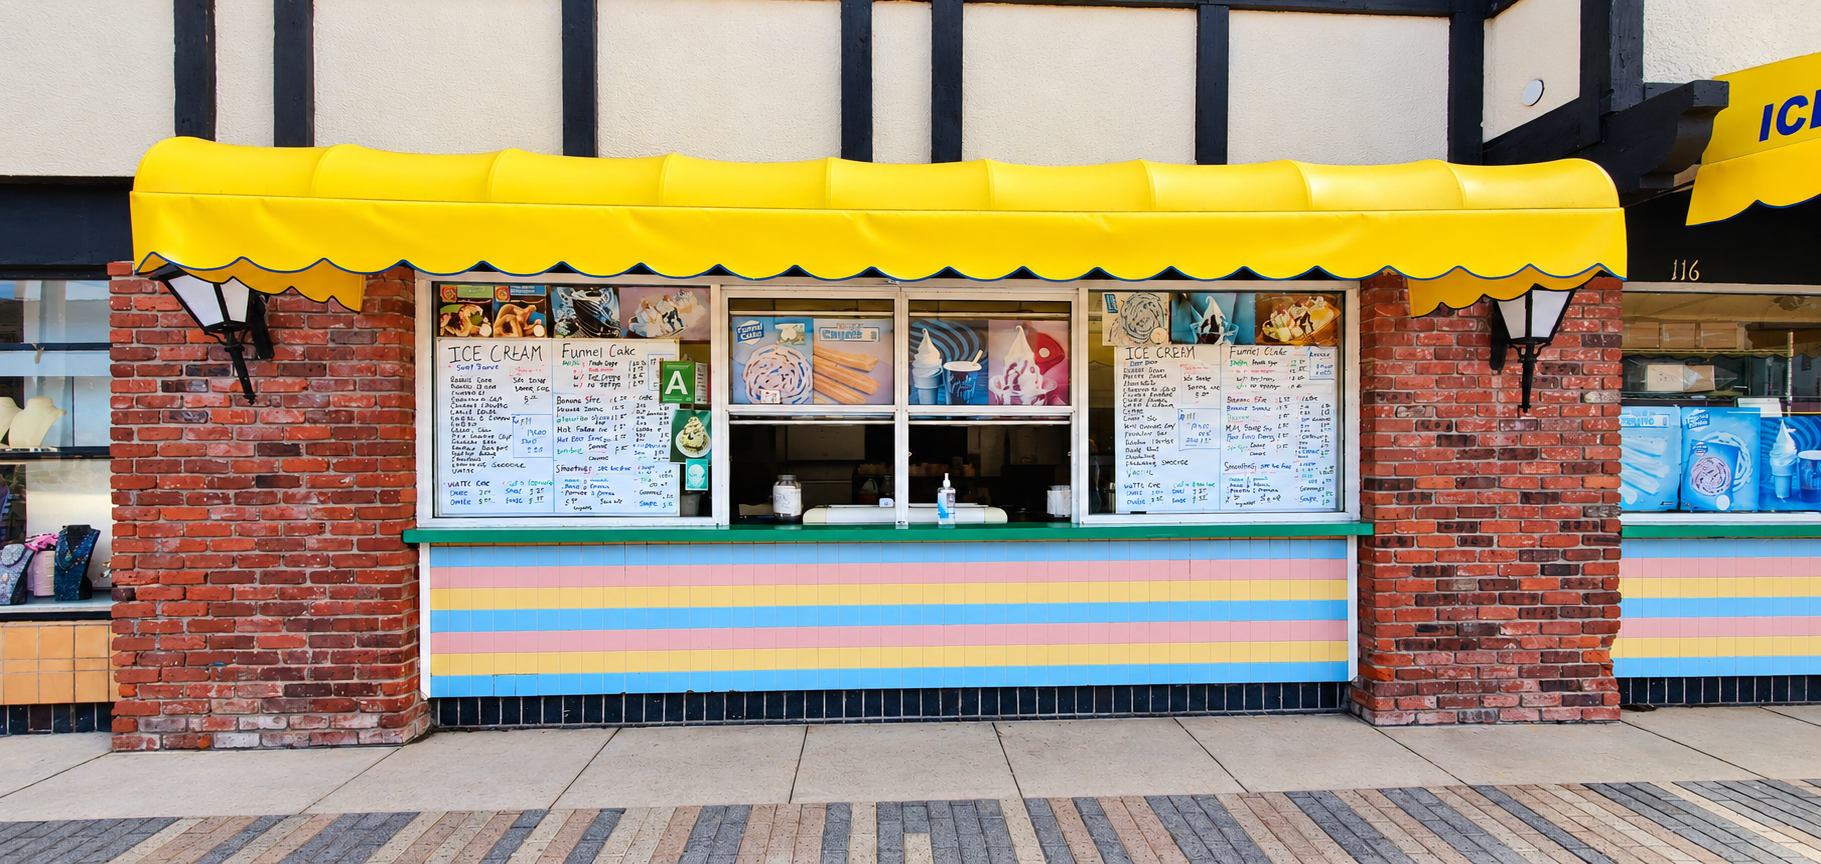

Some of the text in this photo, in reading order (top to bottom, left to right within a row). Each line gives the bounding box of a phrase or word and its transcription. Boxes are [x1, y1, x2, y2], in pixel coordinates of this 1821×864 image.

[1671, 259, 1700, 281] 116
[447, 344, 543, 364] ICE CREAM
[562, 342, 637, 359] Funnel Cake
[1125, 345, 1196, 361] ICE CREAM
[664, 370, 688, 395] A
